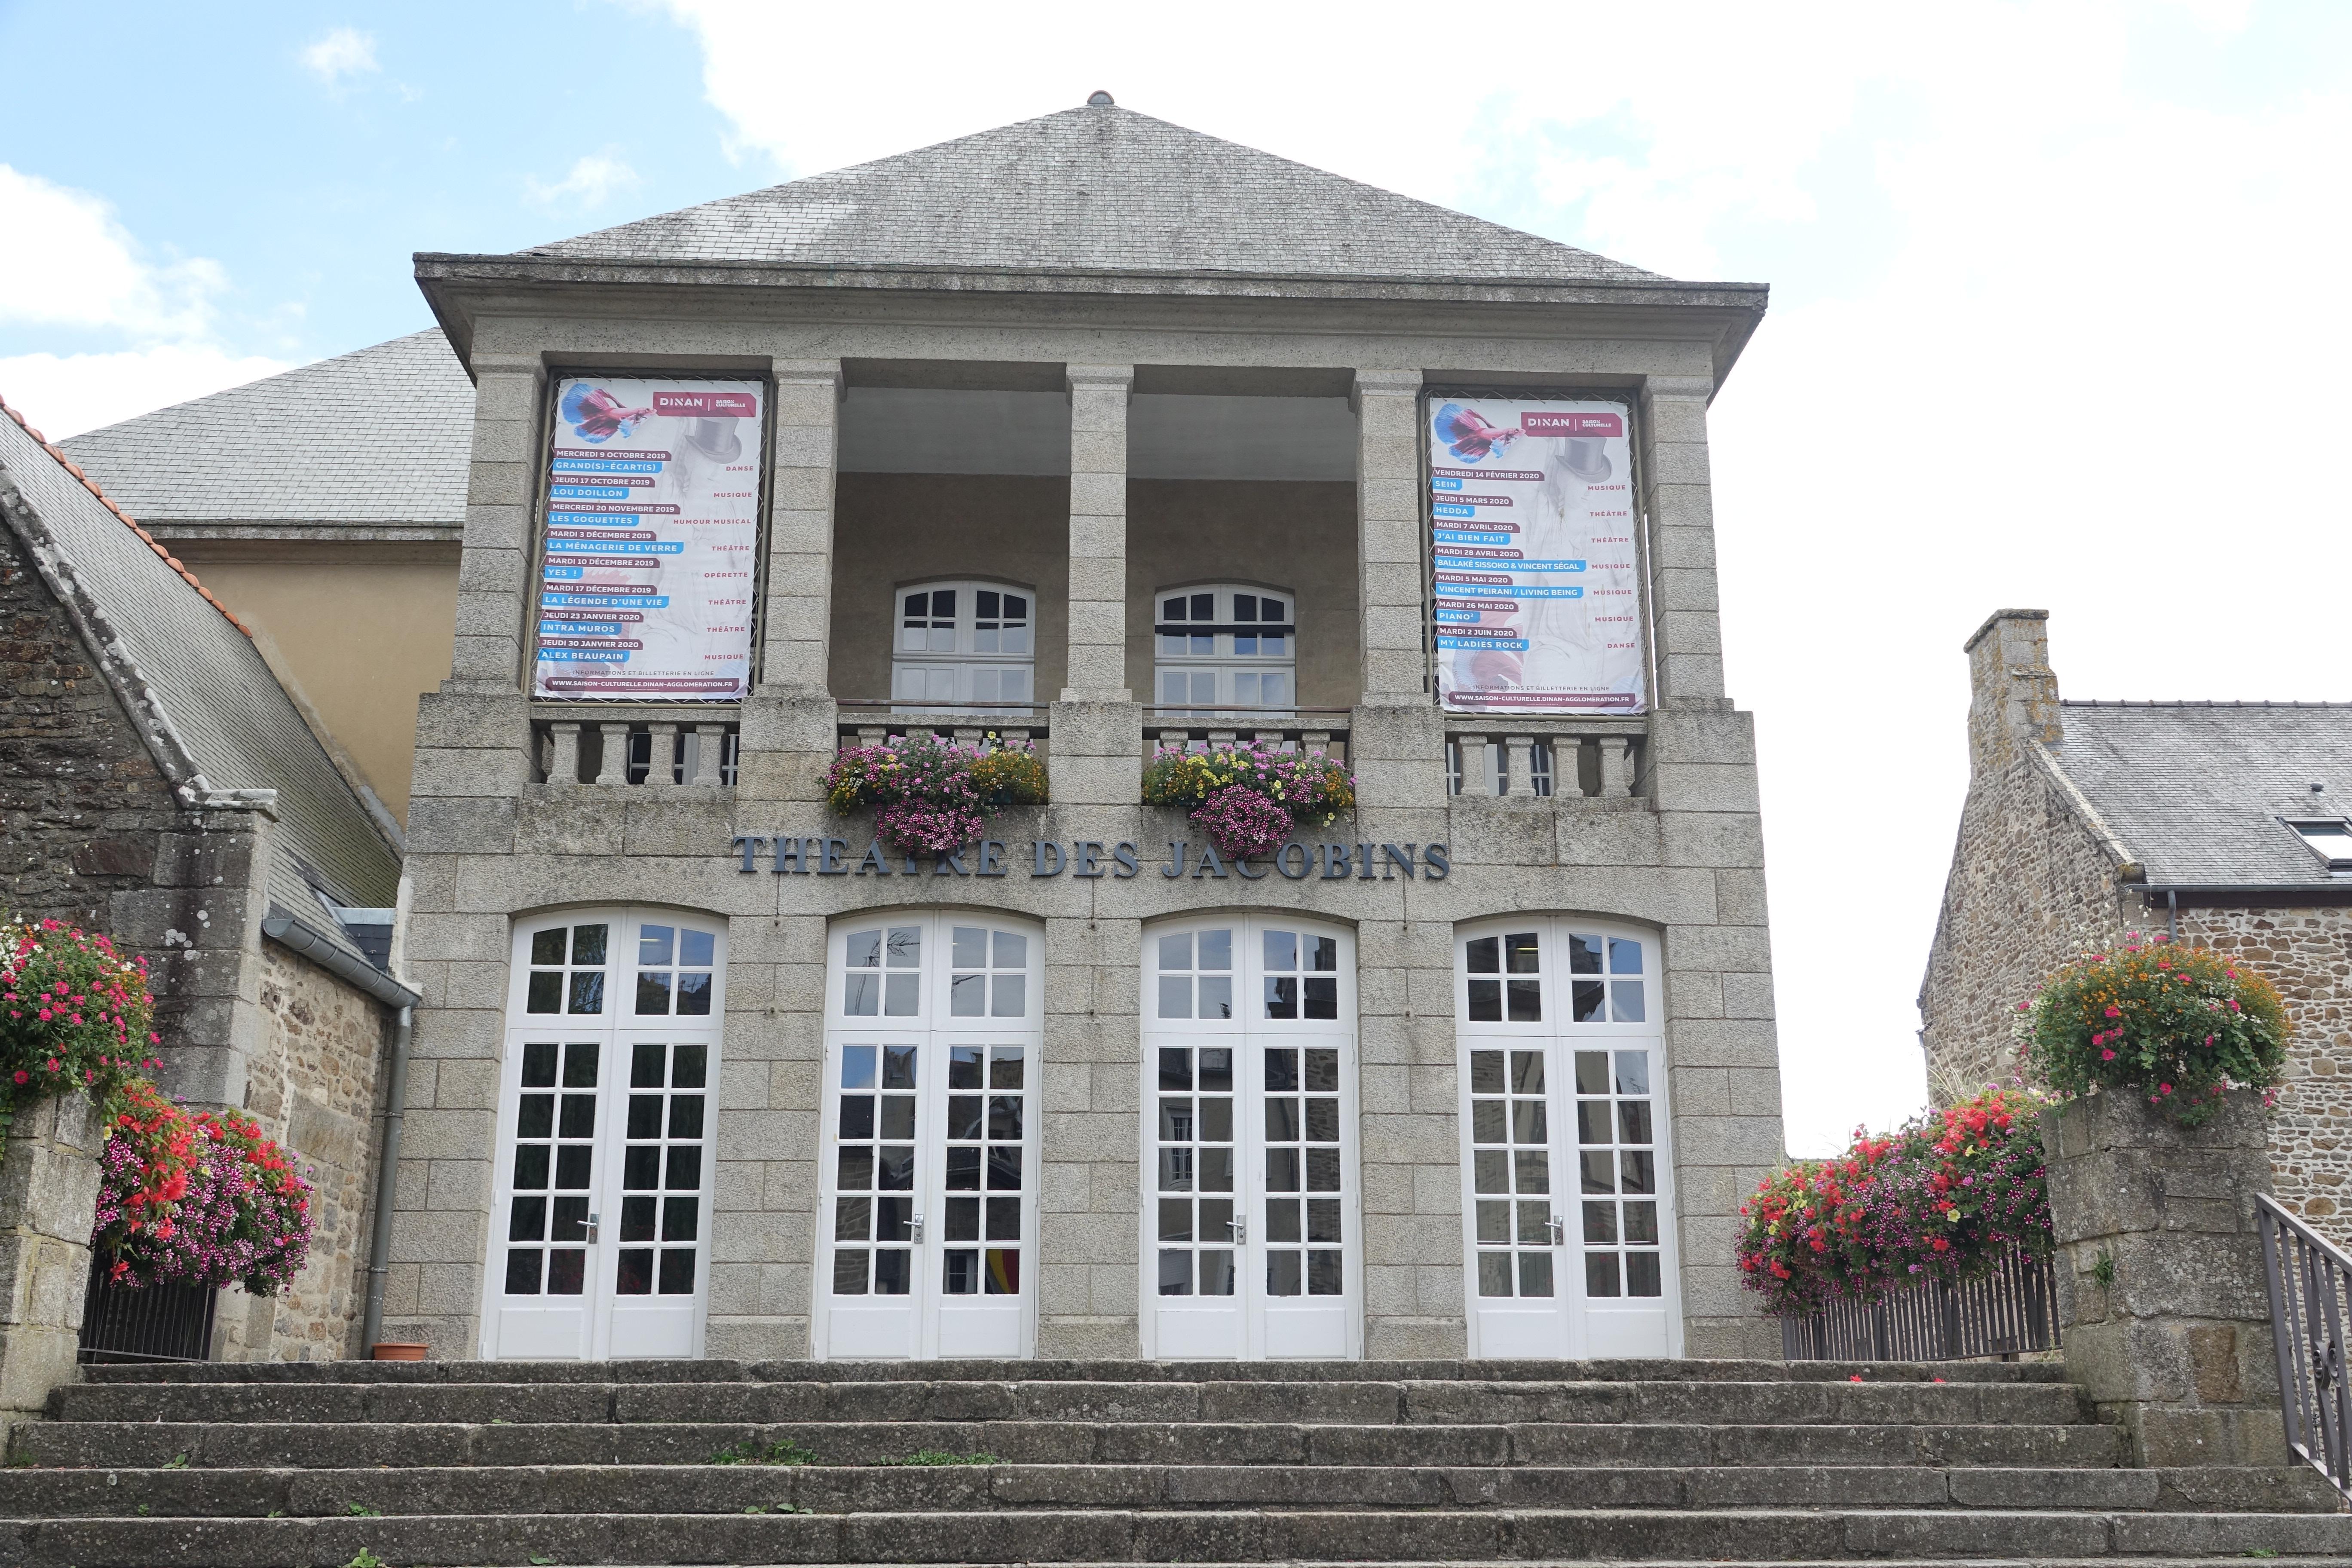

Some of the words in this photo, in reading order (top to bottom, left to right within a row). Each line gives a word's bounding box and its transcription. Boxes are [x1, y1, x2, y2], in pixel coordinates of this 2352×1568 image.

[660, 398, 702, 406] DINAN
[1528, 418, 1569, 426] DINAN
[556, 462, 655, 472] GRAND(S)-ÉCART(S)
[1486, 470, 1518, 478] FÉVRIER
[586, 530, 630, 539] DÉCEMBRE
[566, 541, 624, 551] MÉNAGERIE
[589, 557, 633, 566] DÉCEMBRE
[1438, 558, 1473, 567] BALLAKÉ
[1553, 561, 1579, 570] SÉGAL
[586, 584, 630, 593] DÉCEMBRE
[562, 595, 608, 605] LÉGENDE
[1031, 841, 1139, 877] DES
